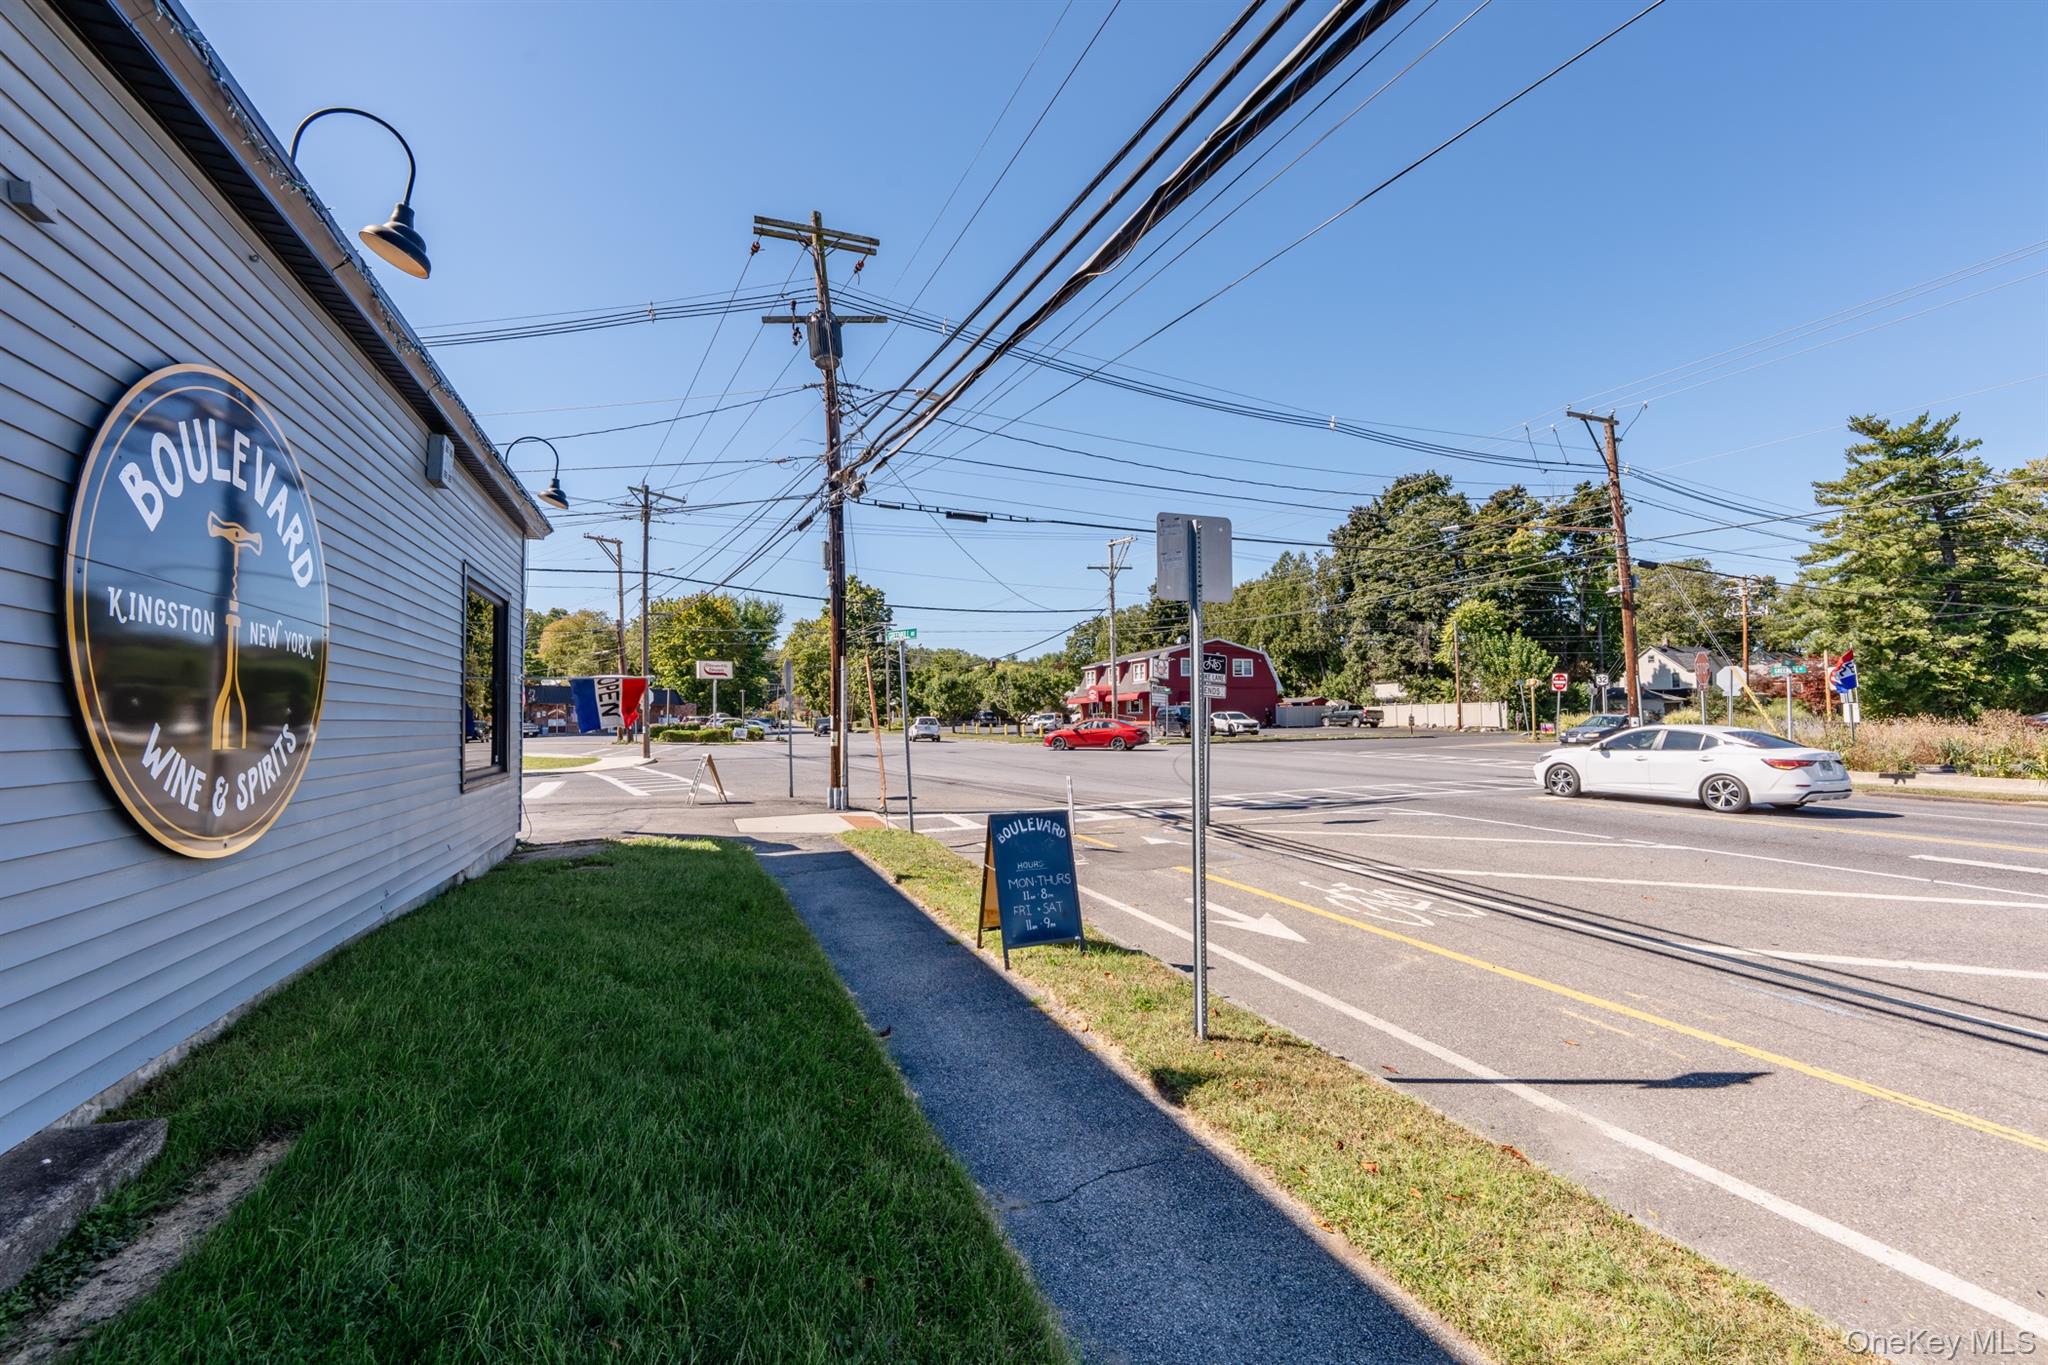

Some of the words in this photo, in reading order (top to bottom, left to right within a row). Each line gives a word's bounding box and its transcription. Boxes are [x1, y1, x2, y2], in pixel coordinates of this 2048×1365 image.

[118, 418, 313, 588] BOULEVARD
[107, 586, 215, 637] KINGSTON
[250, 620, 282, 649] NEW
[285, 630, 315, 660] YORK
[1204, 686, 1220, 695] ENDS
[1597, 676, 1608, 684] 32
[597, 678, 621, 717] OPEN
[141, 722, 206, 813] WINE
[212, 776, 228, 817] &
[236, 723, 297, 811] SPIRITS
[997, 817, 1066, 844] BOULEVARD
[1017, 860, 1045, 870] HOURS
[1013, 905, 1032, 916] FRI
[1043, 901, 1063, 914] SAT
